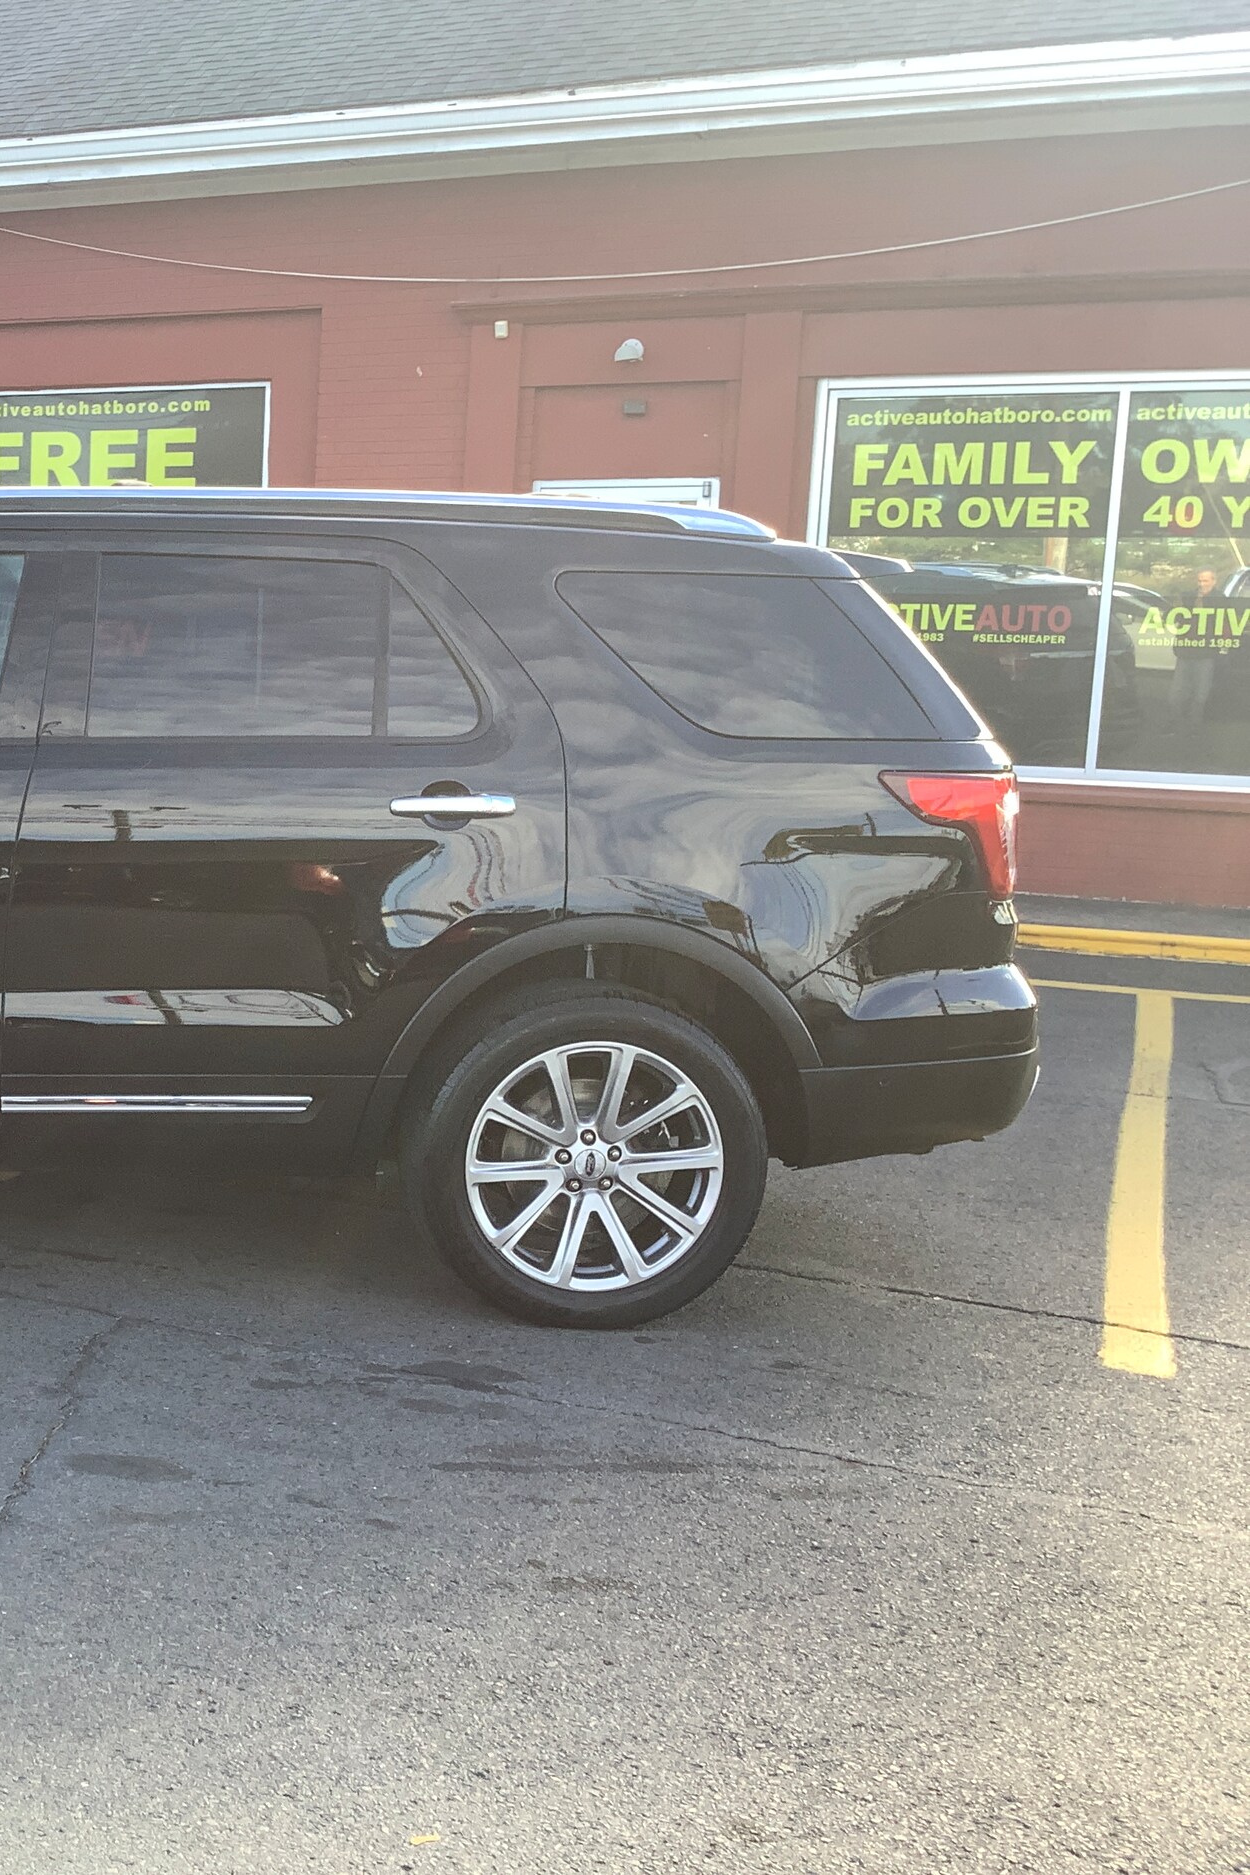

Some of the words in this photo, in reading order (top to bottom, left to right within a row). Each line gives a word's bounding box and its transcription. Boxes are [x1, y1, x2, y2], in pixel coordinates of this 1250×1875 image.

[847, 407, 1111, 426] activeautohatboro.com
[852, 440, 1096, 486] FAMILY
[849, 497, 943, 528] FOR
[957, 496, 1091, 528] OVER
[1142, 495, 1204, 528] 40
[972, 634, 1066, 644] #SELLSCHEAPER
[1137, 637, 1206, 648] established
[1209, 638, 1240, 648] 1983
